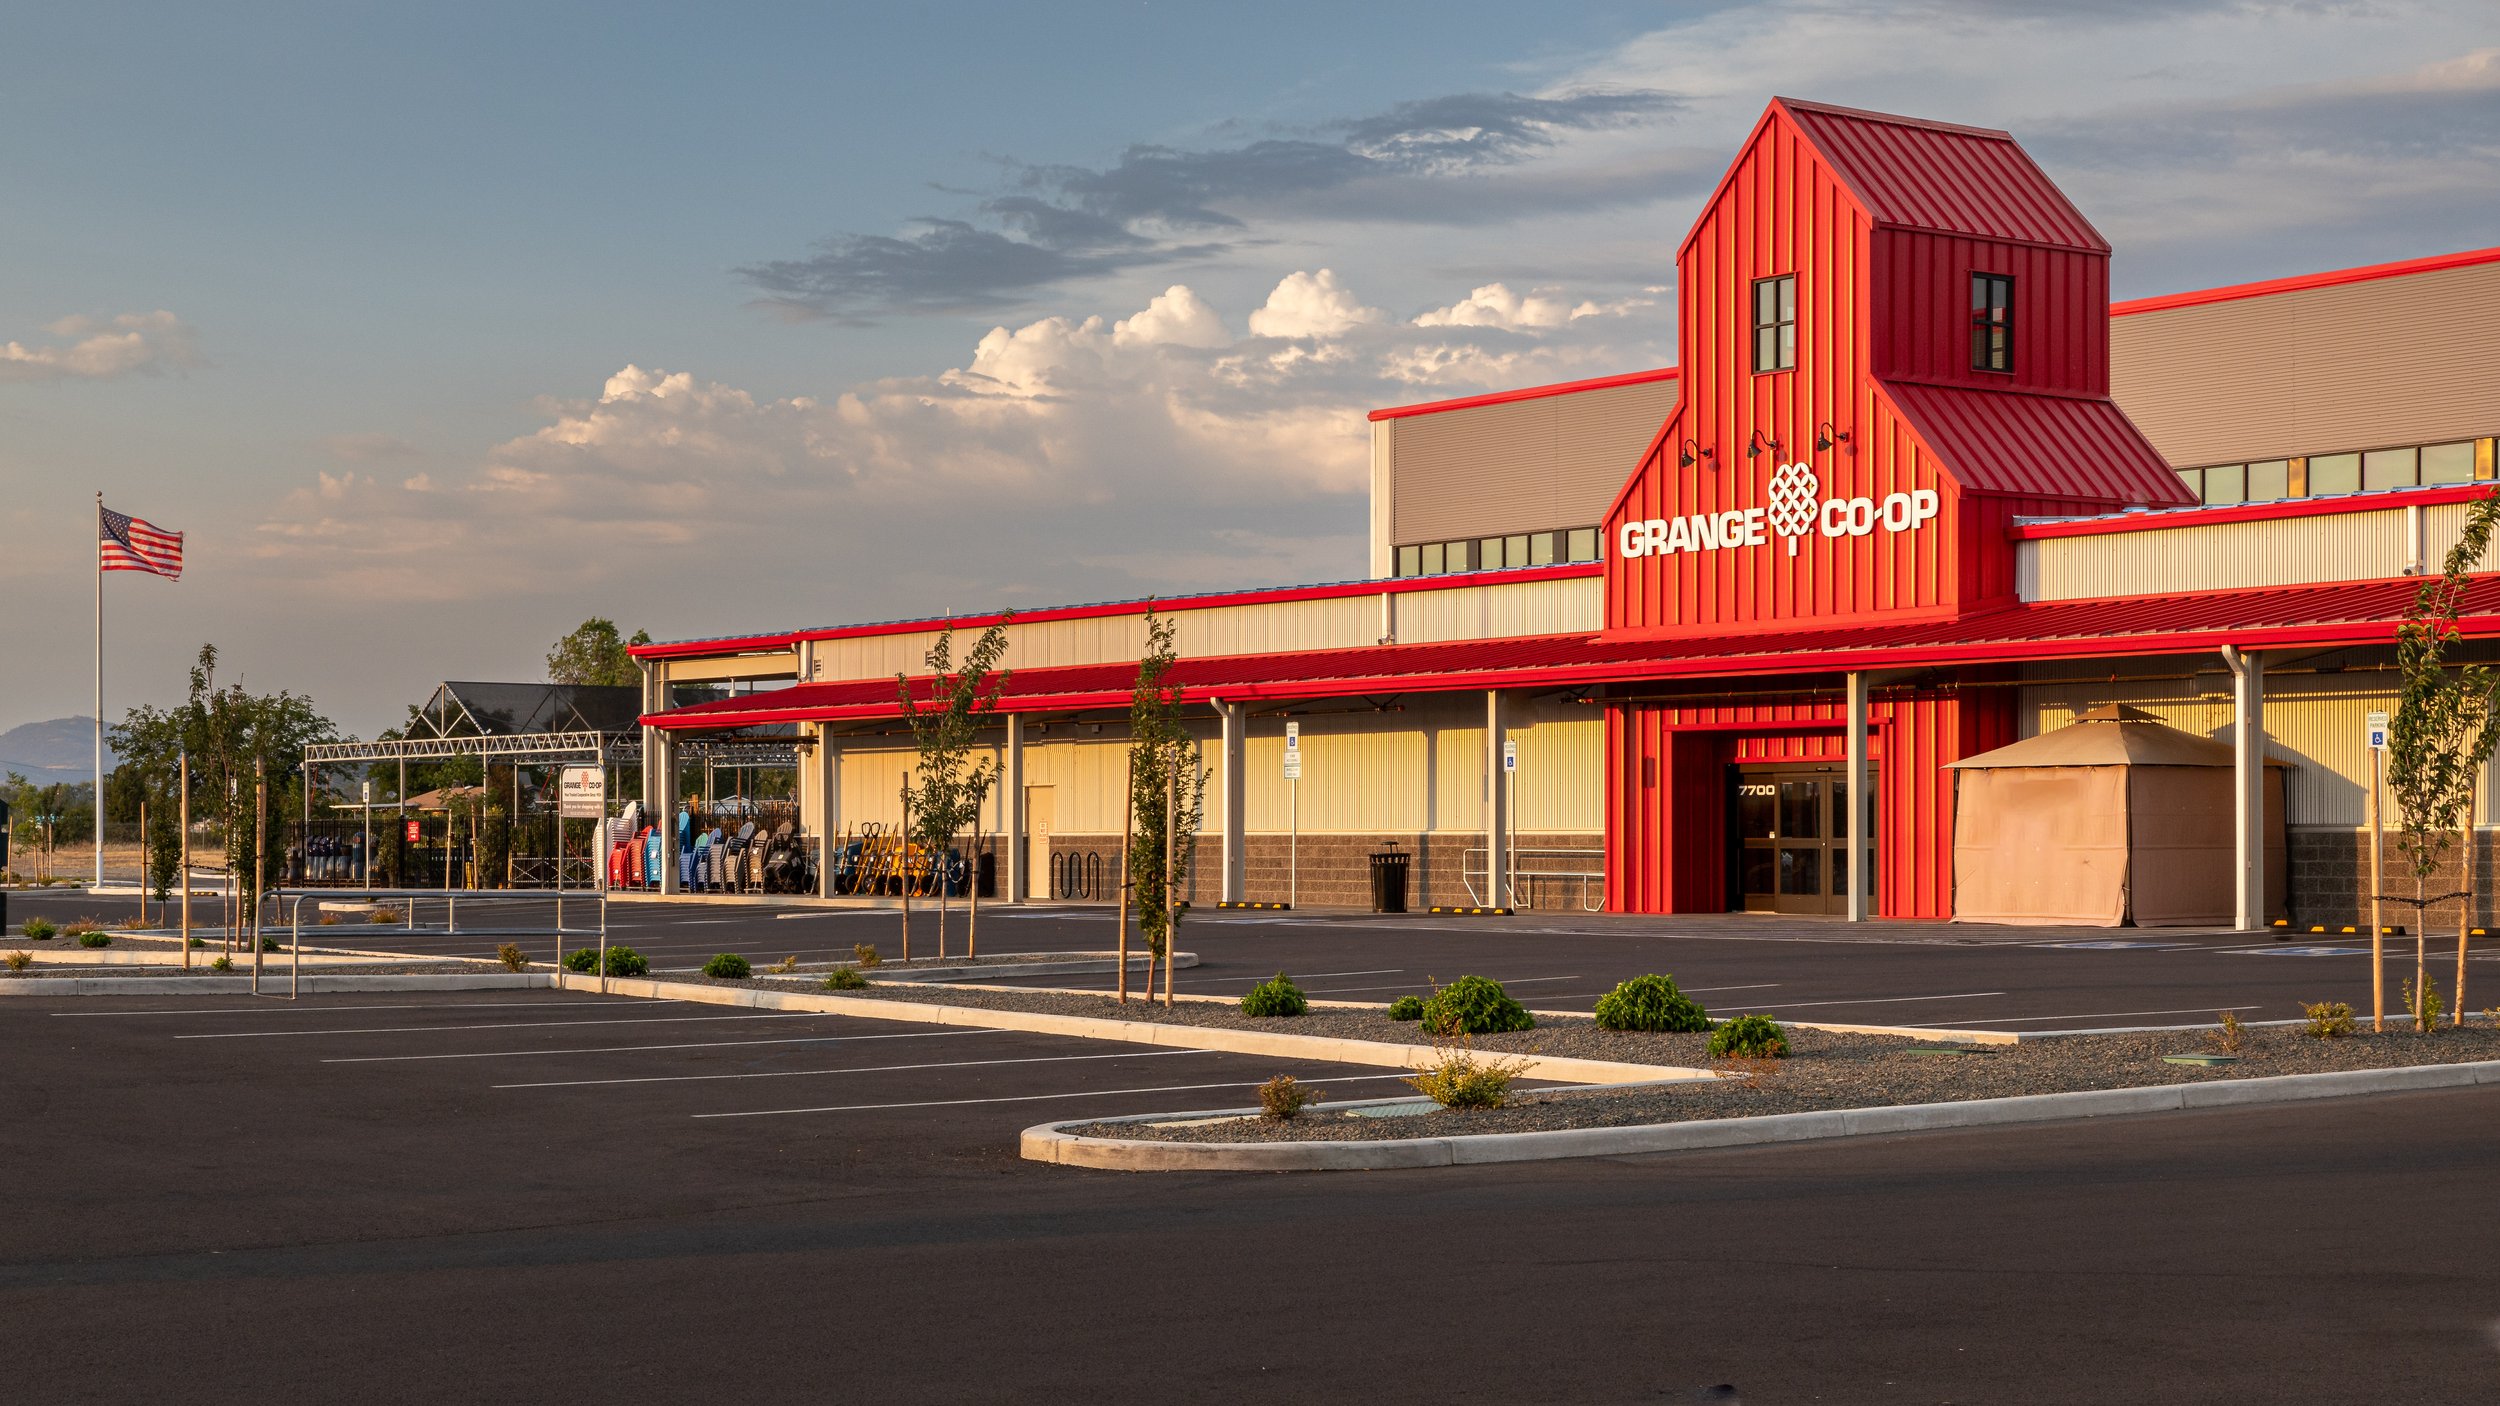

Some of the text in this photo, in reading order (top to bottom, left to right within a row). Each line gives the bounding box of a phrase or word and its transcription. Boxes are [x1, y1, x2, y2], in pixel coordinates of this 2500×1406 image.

[1620, 489, 1939, 559] GRANGE CO-OP
[1738, 784, 1776, 796] 7700
